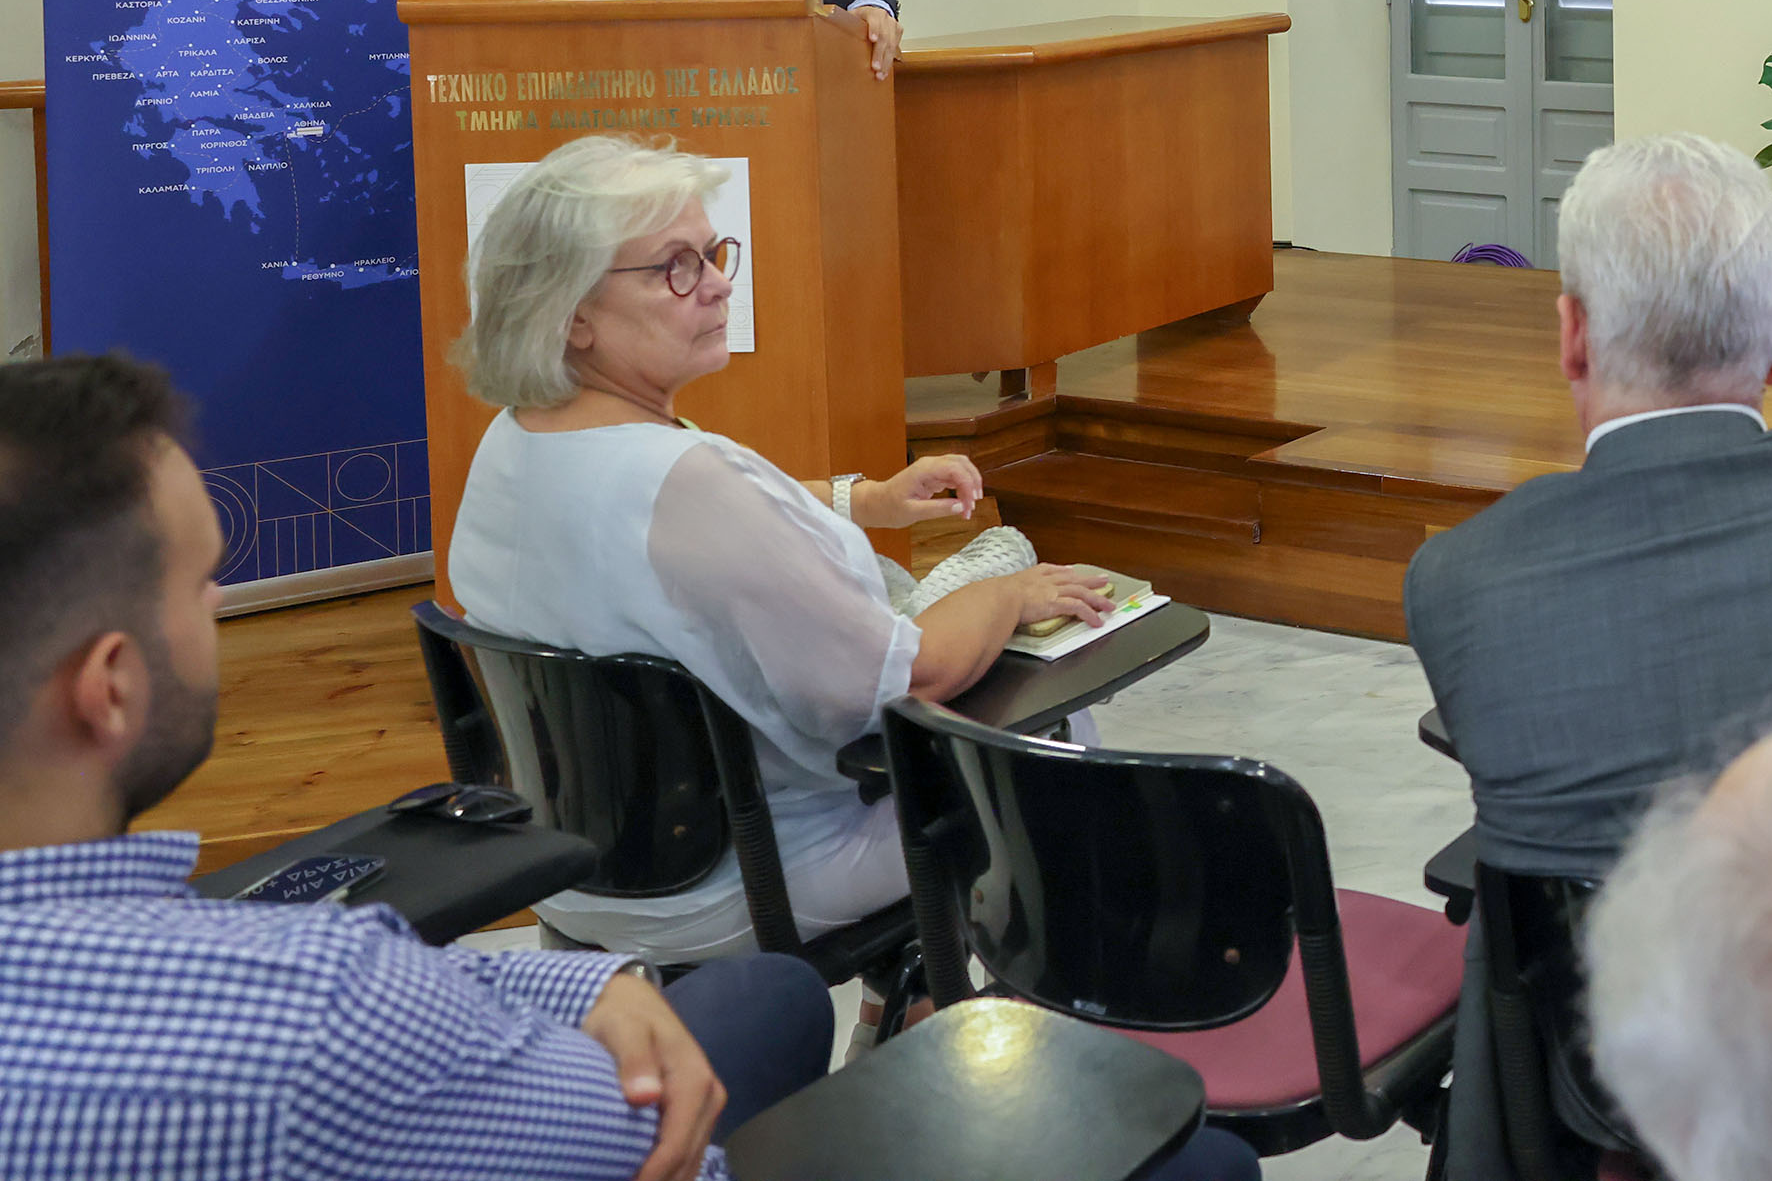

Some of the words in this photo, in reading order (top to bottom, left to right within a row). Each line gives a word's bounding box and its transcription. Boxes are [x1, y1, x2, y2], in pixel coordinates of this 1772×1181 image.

[116, 1, 162, 9] ΚΑΣΤΟΡΙΑ
[167, 16, 206, 24] ΚΟΖΑΝΗ
[237, 17, 280, 27] ΚΑΤΕΡΙΝΗ
[233, 36, 265, 46] ΛΑΡΙΣΑ
[66, 54, 108, 62] ΚΕΡΚΥΡΑ
[257, 56, 288, 64] ΒΟΛΟΣ
[93, 72, 135, 81] ΠΡΕΒΕΖΑ
[190, 69, 234, 77] ΚΑΡΔΙΤΣΑ
[427, 73, 506, 102] ΤΕΧΝΙΚΟ
[517, 69, 655, 100] ΕΠΙΜΕΛΗΤΗΡΙΟ
[664, 69, 700, 97] ΤΗΣ
[709, 67, 799, 96] ΕΛΛΑΔΟΣ
[190, 90, 219, 98] ΛΑΜΙΑ
[135, 97, 173, 107] ΑΓΡΙΝΙΟ
[293, 101, 331, 109] ΧΑΛΚΙΔΑ
[233, 111, 275, 120] ΛΙΒΑΔΕΙΑ
[456, 110, 539, 131] ΤΜΗΜΑ
[192, 128, 220, 136] ΠΑΤΡΑ
[133, 142, 169, 150] ΠΥΡΓΟΣ
[201, 140, 248, 149] ΚΟΡΙΝΘΟΣ
[196, 165, 234, 174] ΤΡΙΠΟΛΗ
[248, 162, 288, 171] ΝΑΥΠΛΙΟ
[139, 185, 189, 194] ΚΑΛΑΜΑΤΑ
[261, 260, 288, 269] ΧΑΝΙΑ
[354, 256, 395, 267] ΗΡΑΚΛΕΙΟ
[302, 271, 344, 281] ΡΕΘΥΜΝΟ
